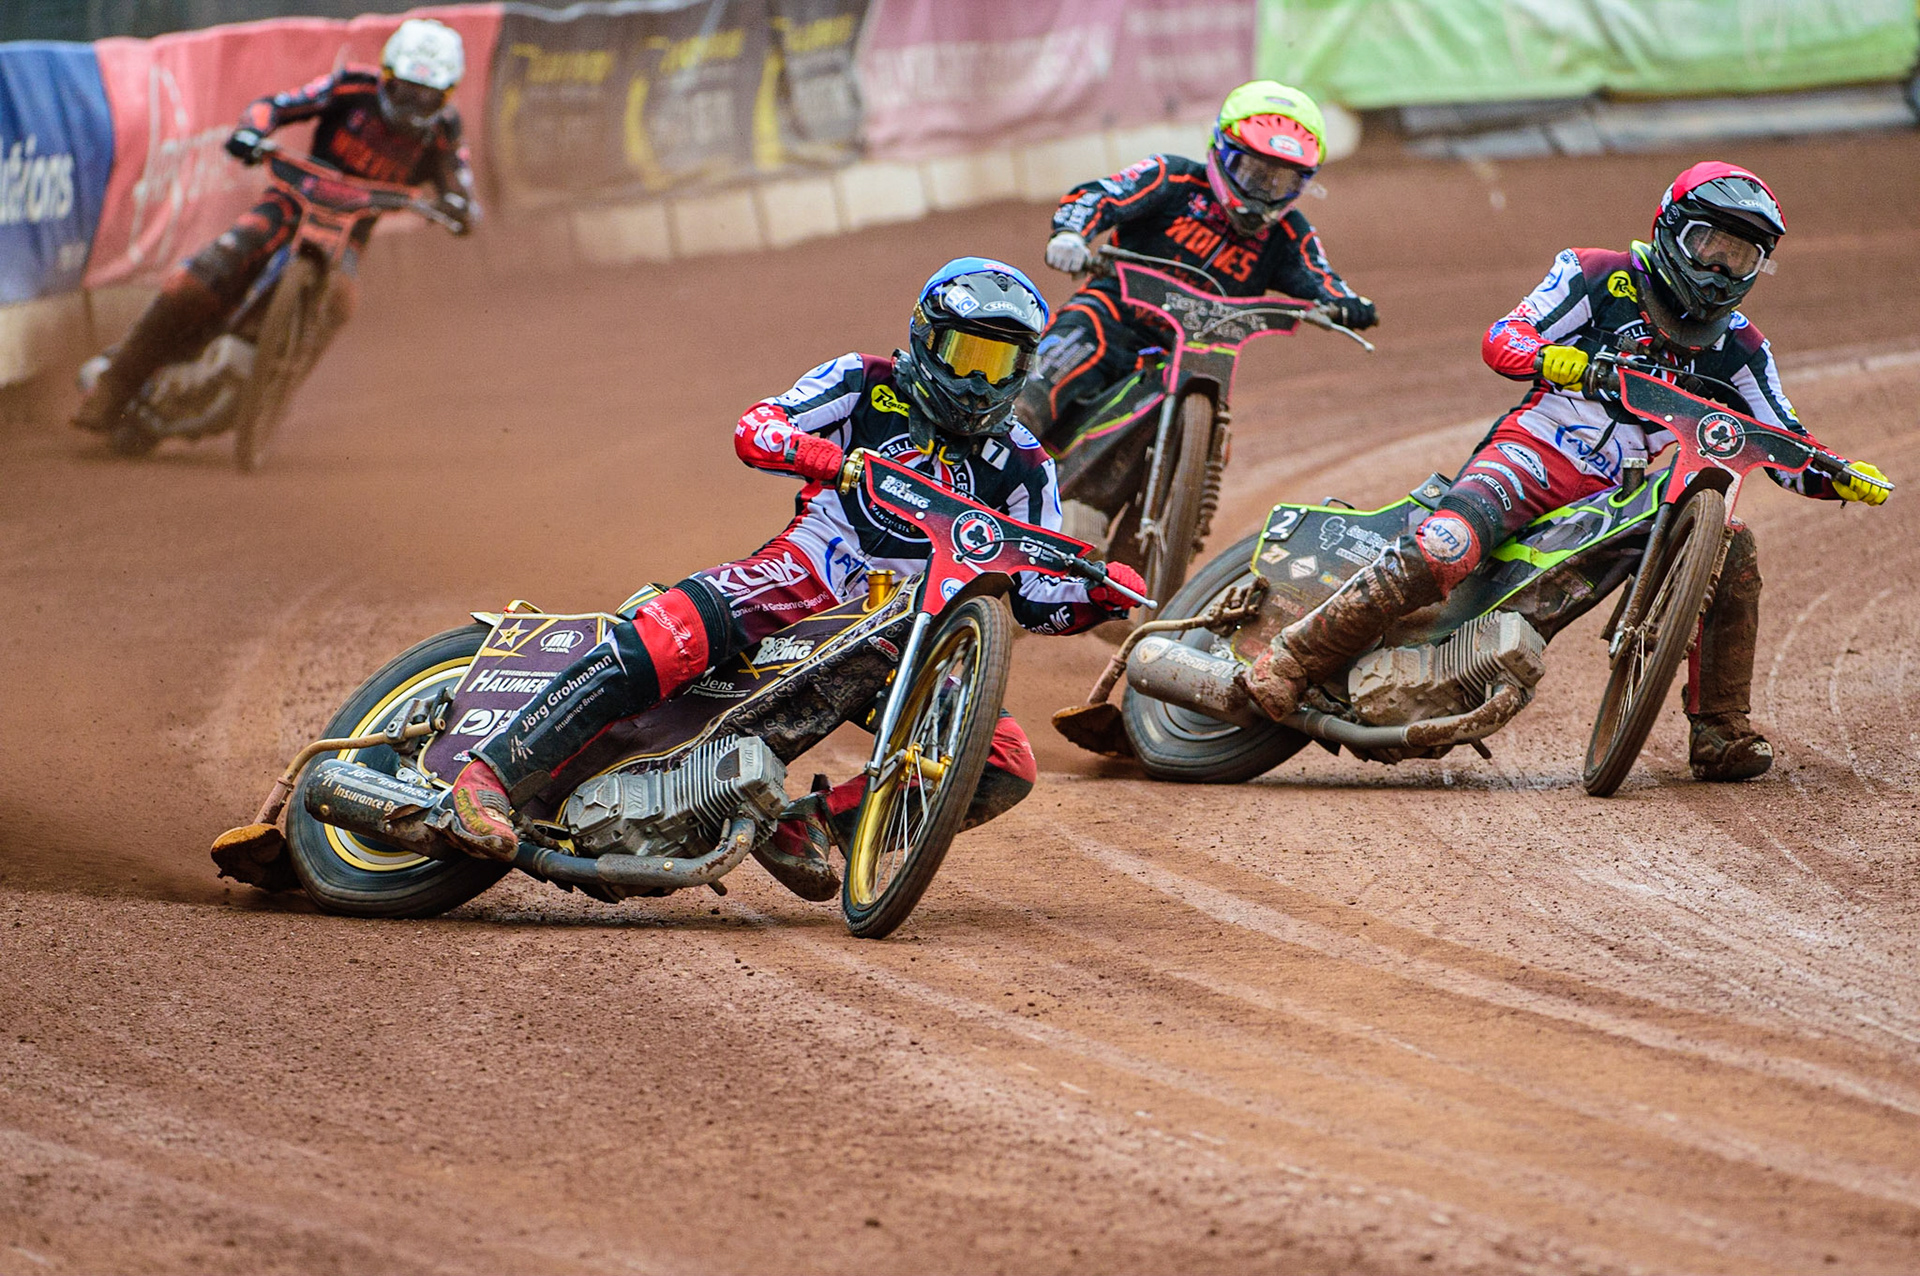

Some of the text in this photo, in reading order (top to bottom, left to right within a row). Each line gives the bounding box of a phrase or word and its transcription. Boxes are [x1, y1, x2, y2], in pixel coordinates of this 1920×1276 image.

[988, 441, 1005, 464] 7
[880, 480, 930, 509] RACING
[958, 513, 976, 525] BELLE
[978, 514, 992, 524] VUE
[1269, 510, 1298, 534] 2
[1432, 523, 1460, 550] ATPI
[1050, 605, 1071, 631] MF
[520, 704, 550, 733] Jörg
[547, 655, 613, 706] Grohmann
[700, 676, 735, 691] Jens
[554, 687, 605, 733] Insurance Broker
[334, 784, 385, 810] Insurance
